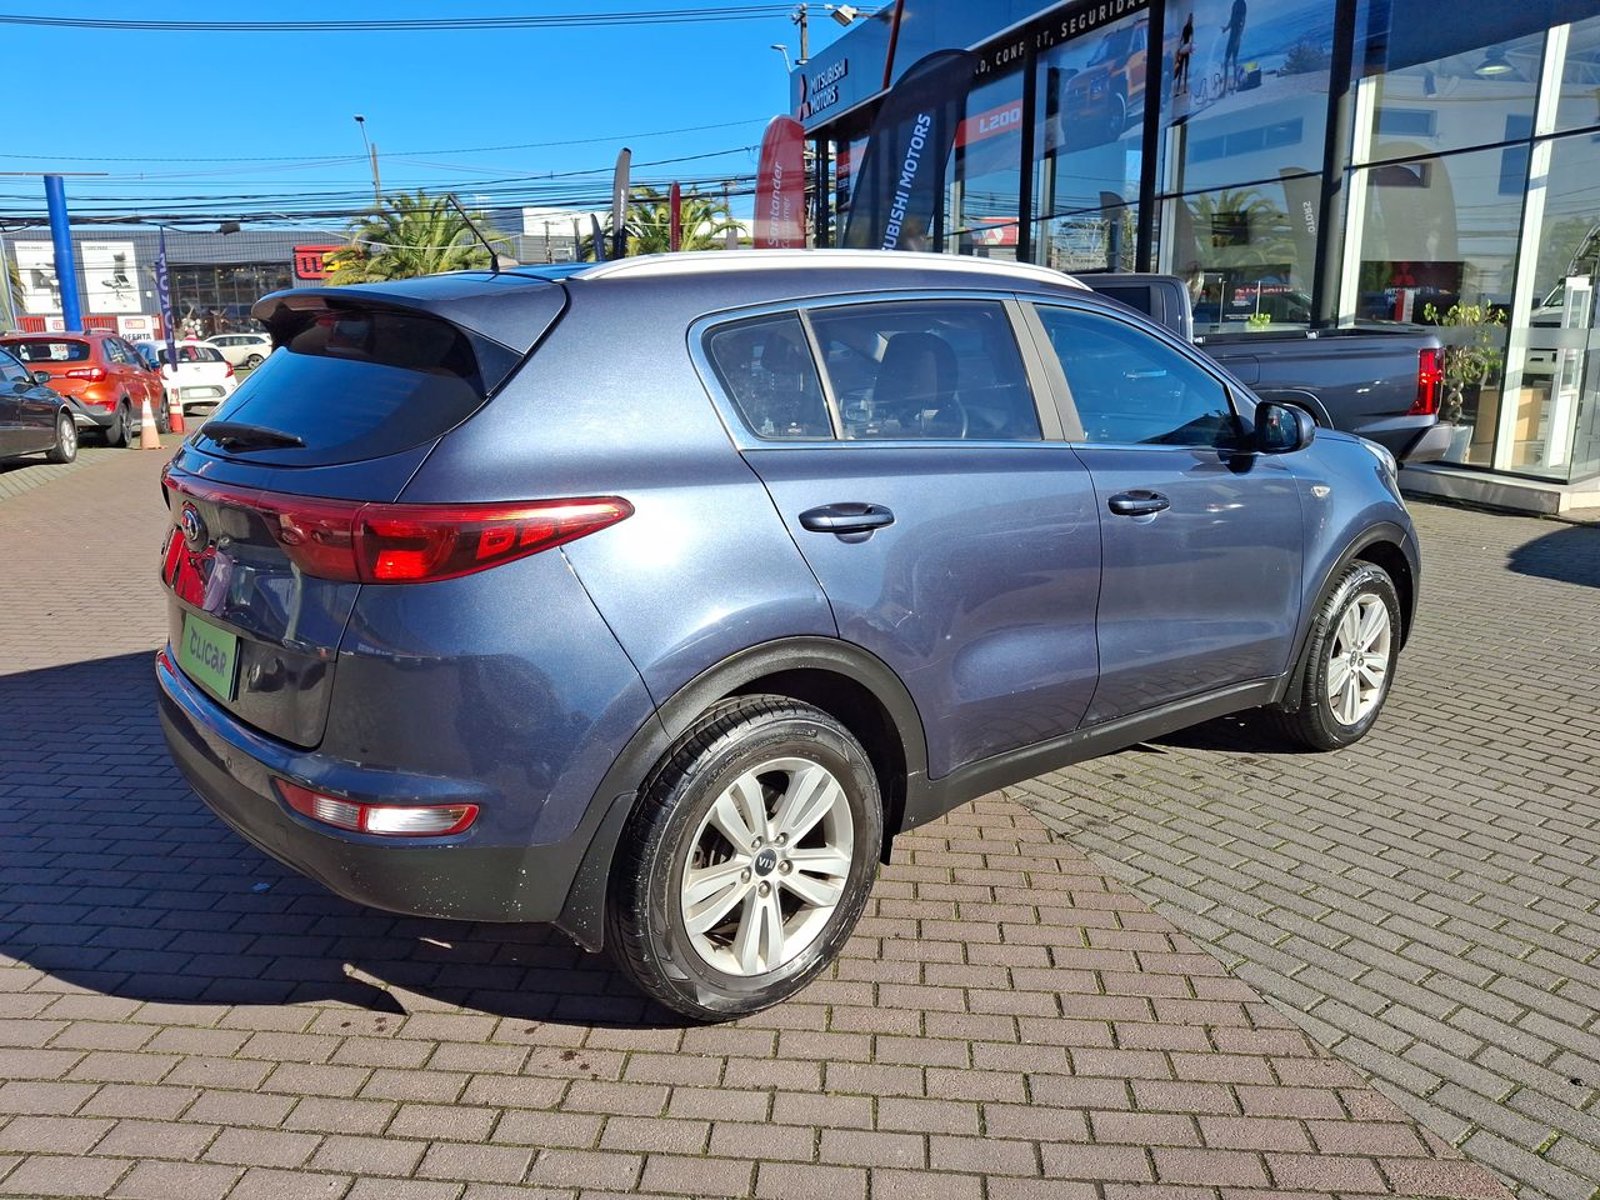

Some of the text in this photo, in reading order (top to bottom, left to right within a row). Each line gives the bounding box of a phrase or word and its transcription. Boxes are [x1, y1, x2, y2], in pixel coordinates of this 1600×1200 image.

[995, 30, 1054, 66] CONFT,
[811, 58, 848, 95] MITSUBISHI
[810, 85, 838, 115] MOTORS
[979, 107, 1021, 134] L200
[900, 113, 931, 189] MOTORS
[768, 160, 783, 247] Santander
[121, 332, 152, 341] OFERTA
[758, 856, 776, 870] KIA
